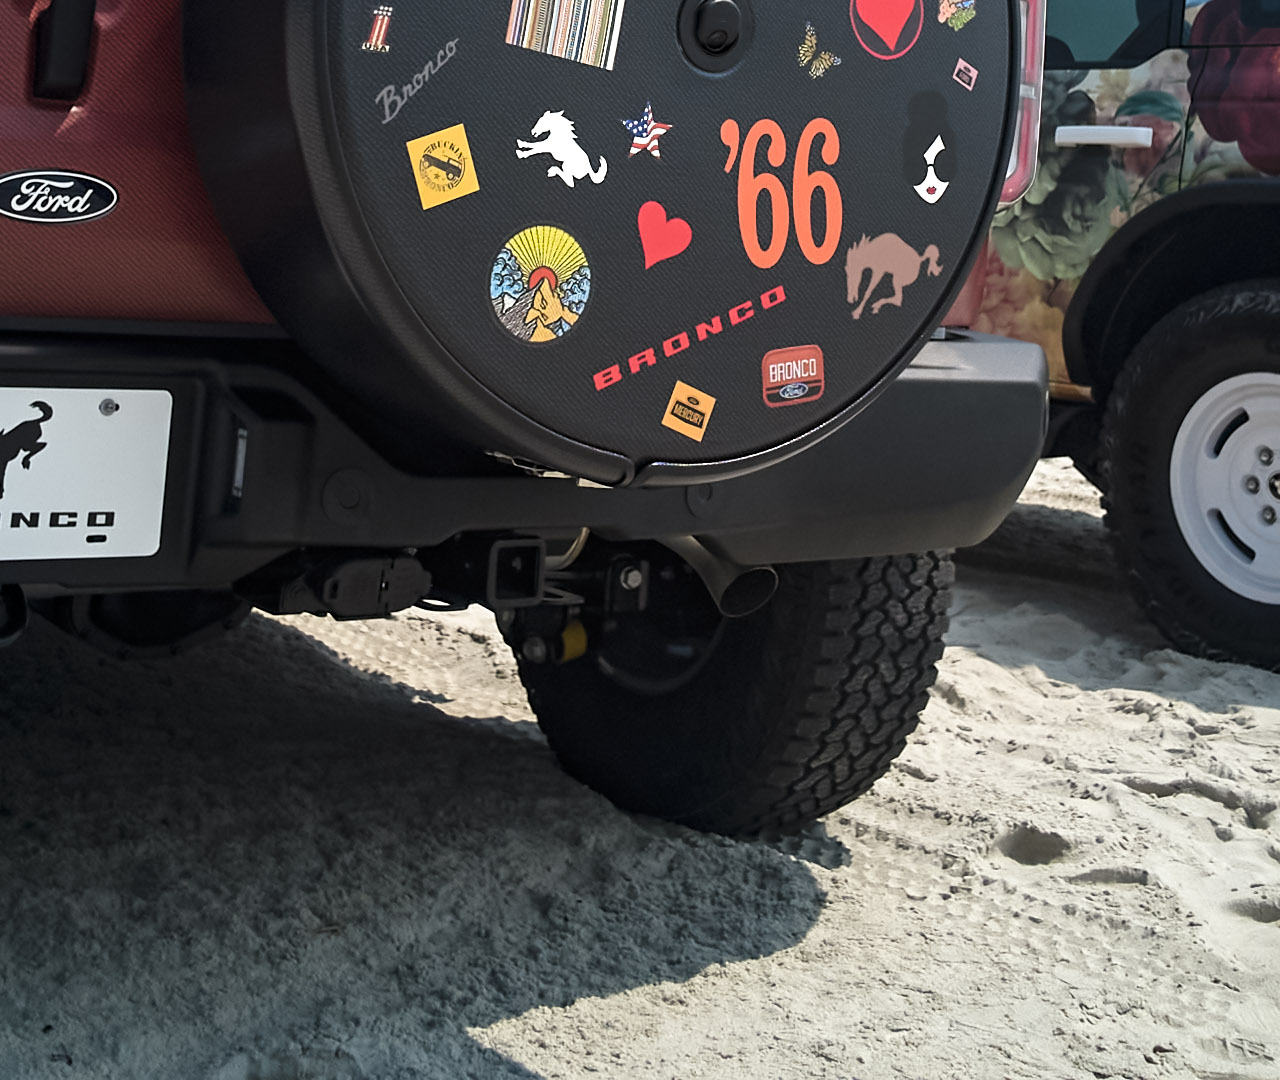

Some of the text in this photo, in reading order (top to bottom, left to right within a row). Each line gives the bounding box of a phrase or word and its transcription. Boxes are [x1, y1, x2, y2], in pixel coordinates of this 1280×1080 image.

[362, 42, 390, 53] USA
[374, 37, 460, 125] Bronco
[10, 178, 94, 214] Ford
[720, 117, 843, 269] '66
[592, 285, 787, 392] BRONCO
[769, 358, 817, 383] BRONCO
